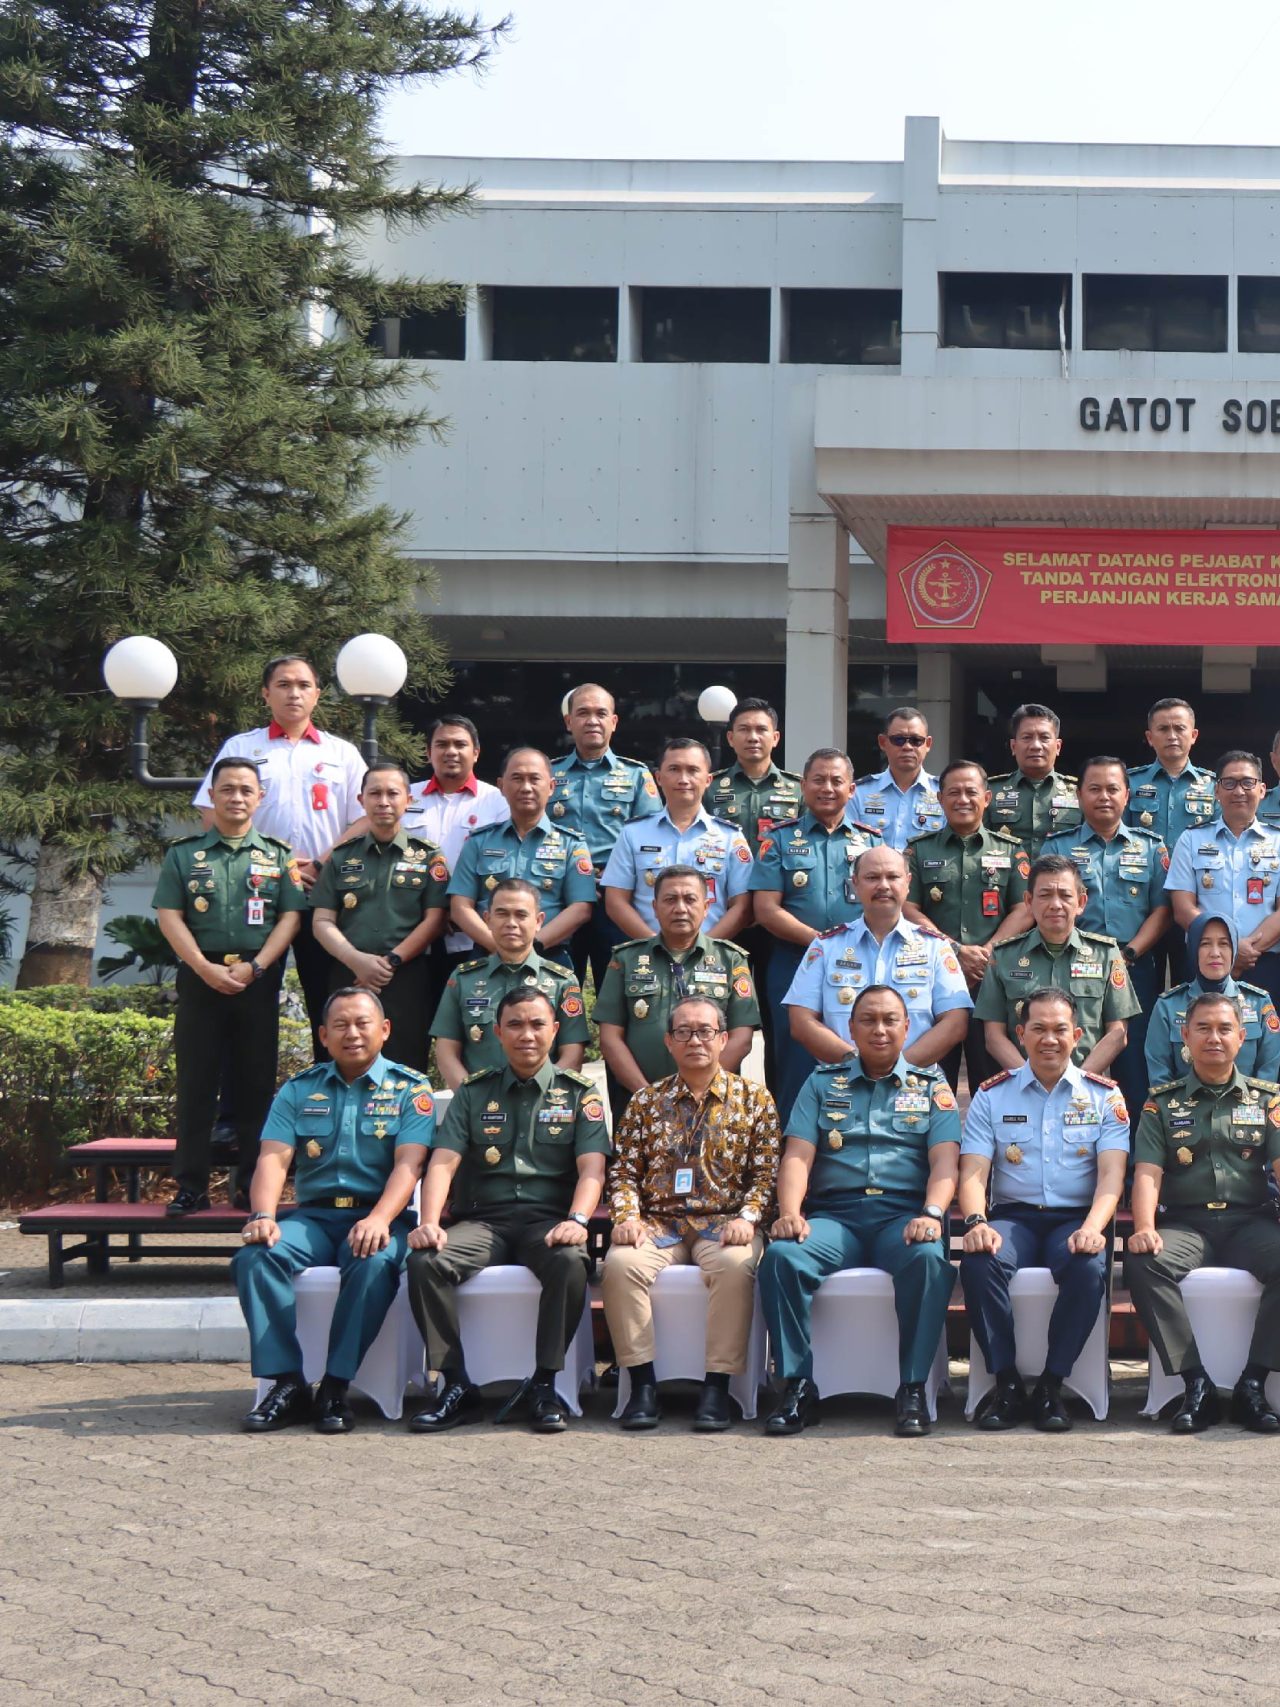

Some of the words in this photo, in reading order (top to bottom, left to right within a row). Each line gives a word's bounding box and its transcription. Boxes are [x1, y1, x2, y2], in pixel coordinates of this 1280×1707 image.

[1080, 397, 1196, 432] GATOT
[1002, 552, 1092, 567] SELAMAT
[1098, 553, 1174, 568] DATANG
[1180, 554, 1265, 569] PEJABAT
[1020, 571, 1084, 586] TANDA
[1090, 572, 1169, 587] TANGAN
[1040, 590, 1162, 605] PERJANJIAN
[1166, 591, 1230, 606] KERJA
